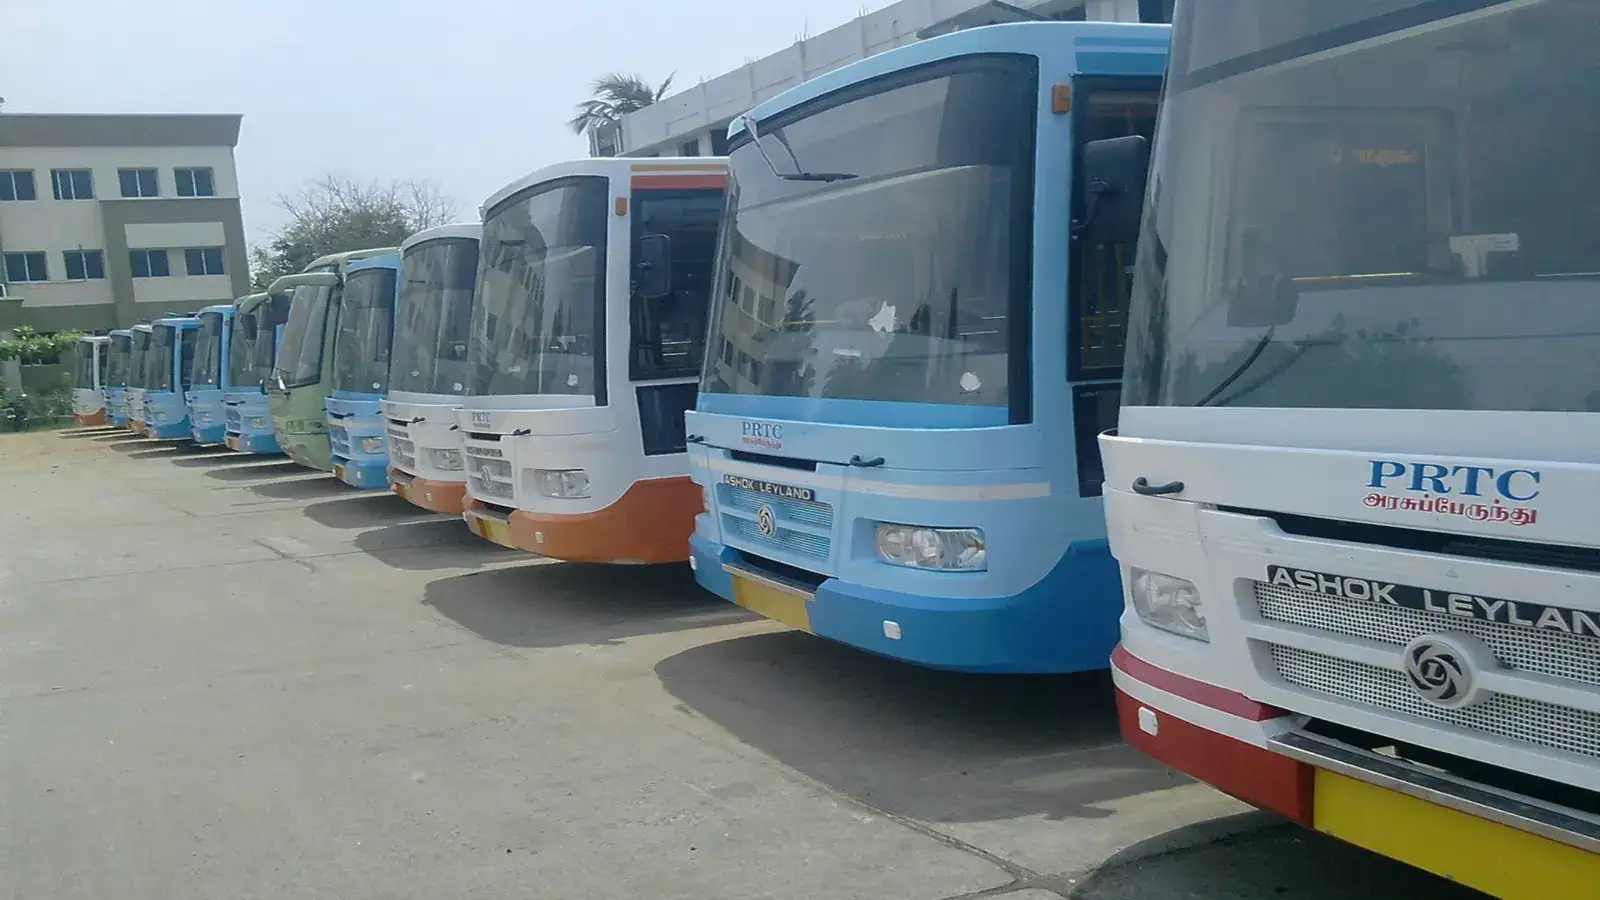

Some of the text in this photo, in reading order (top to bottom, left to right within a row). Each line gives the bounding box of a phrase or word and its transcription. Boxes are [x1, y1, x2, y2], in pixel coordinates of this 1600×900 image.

[741, 421, 783, 439] PRTC
[724, 475, 811, 500] ASHOK LEYLAND
[1365, 460, 1541, 501] PRTC
[1363, 493, 1537, 526] அரசுப்பேருந்து
[1272, 567, 1398, 605] ASHOK
